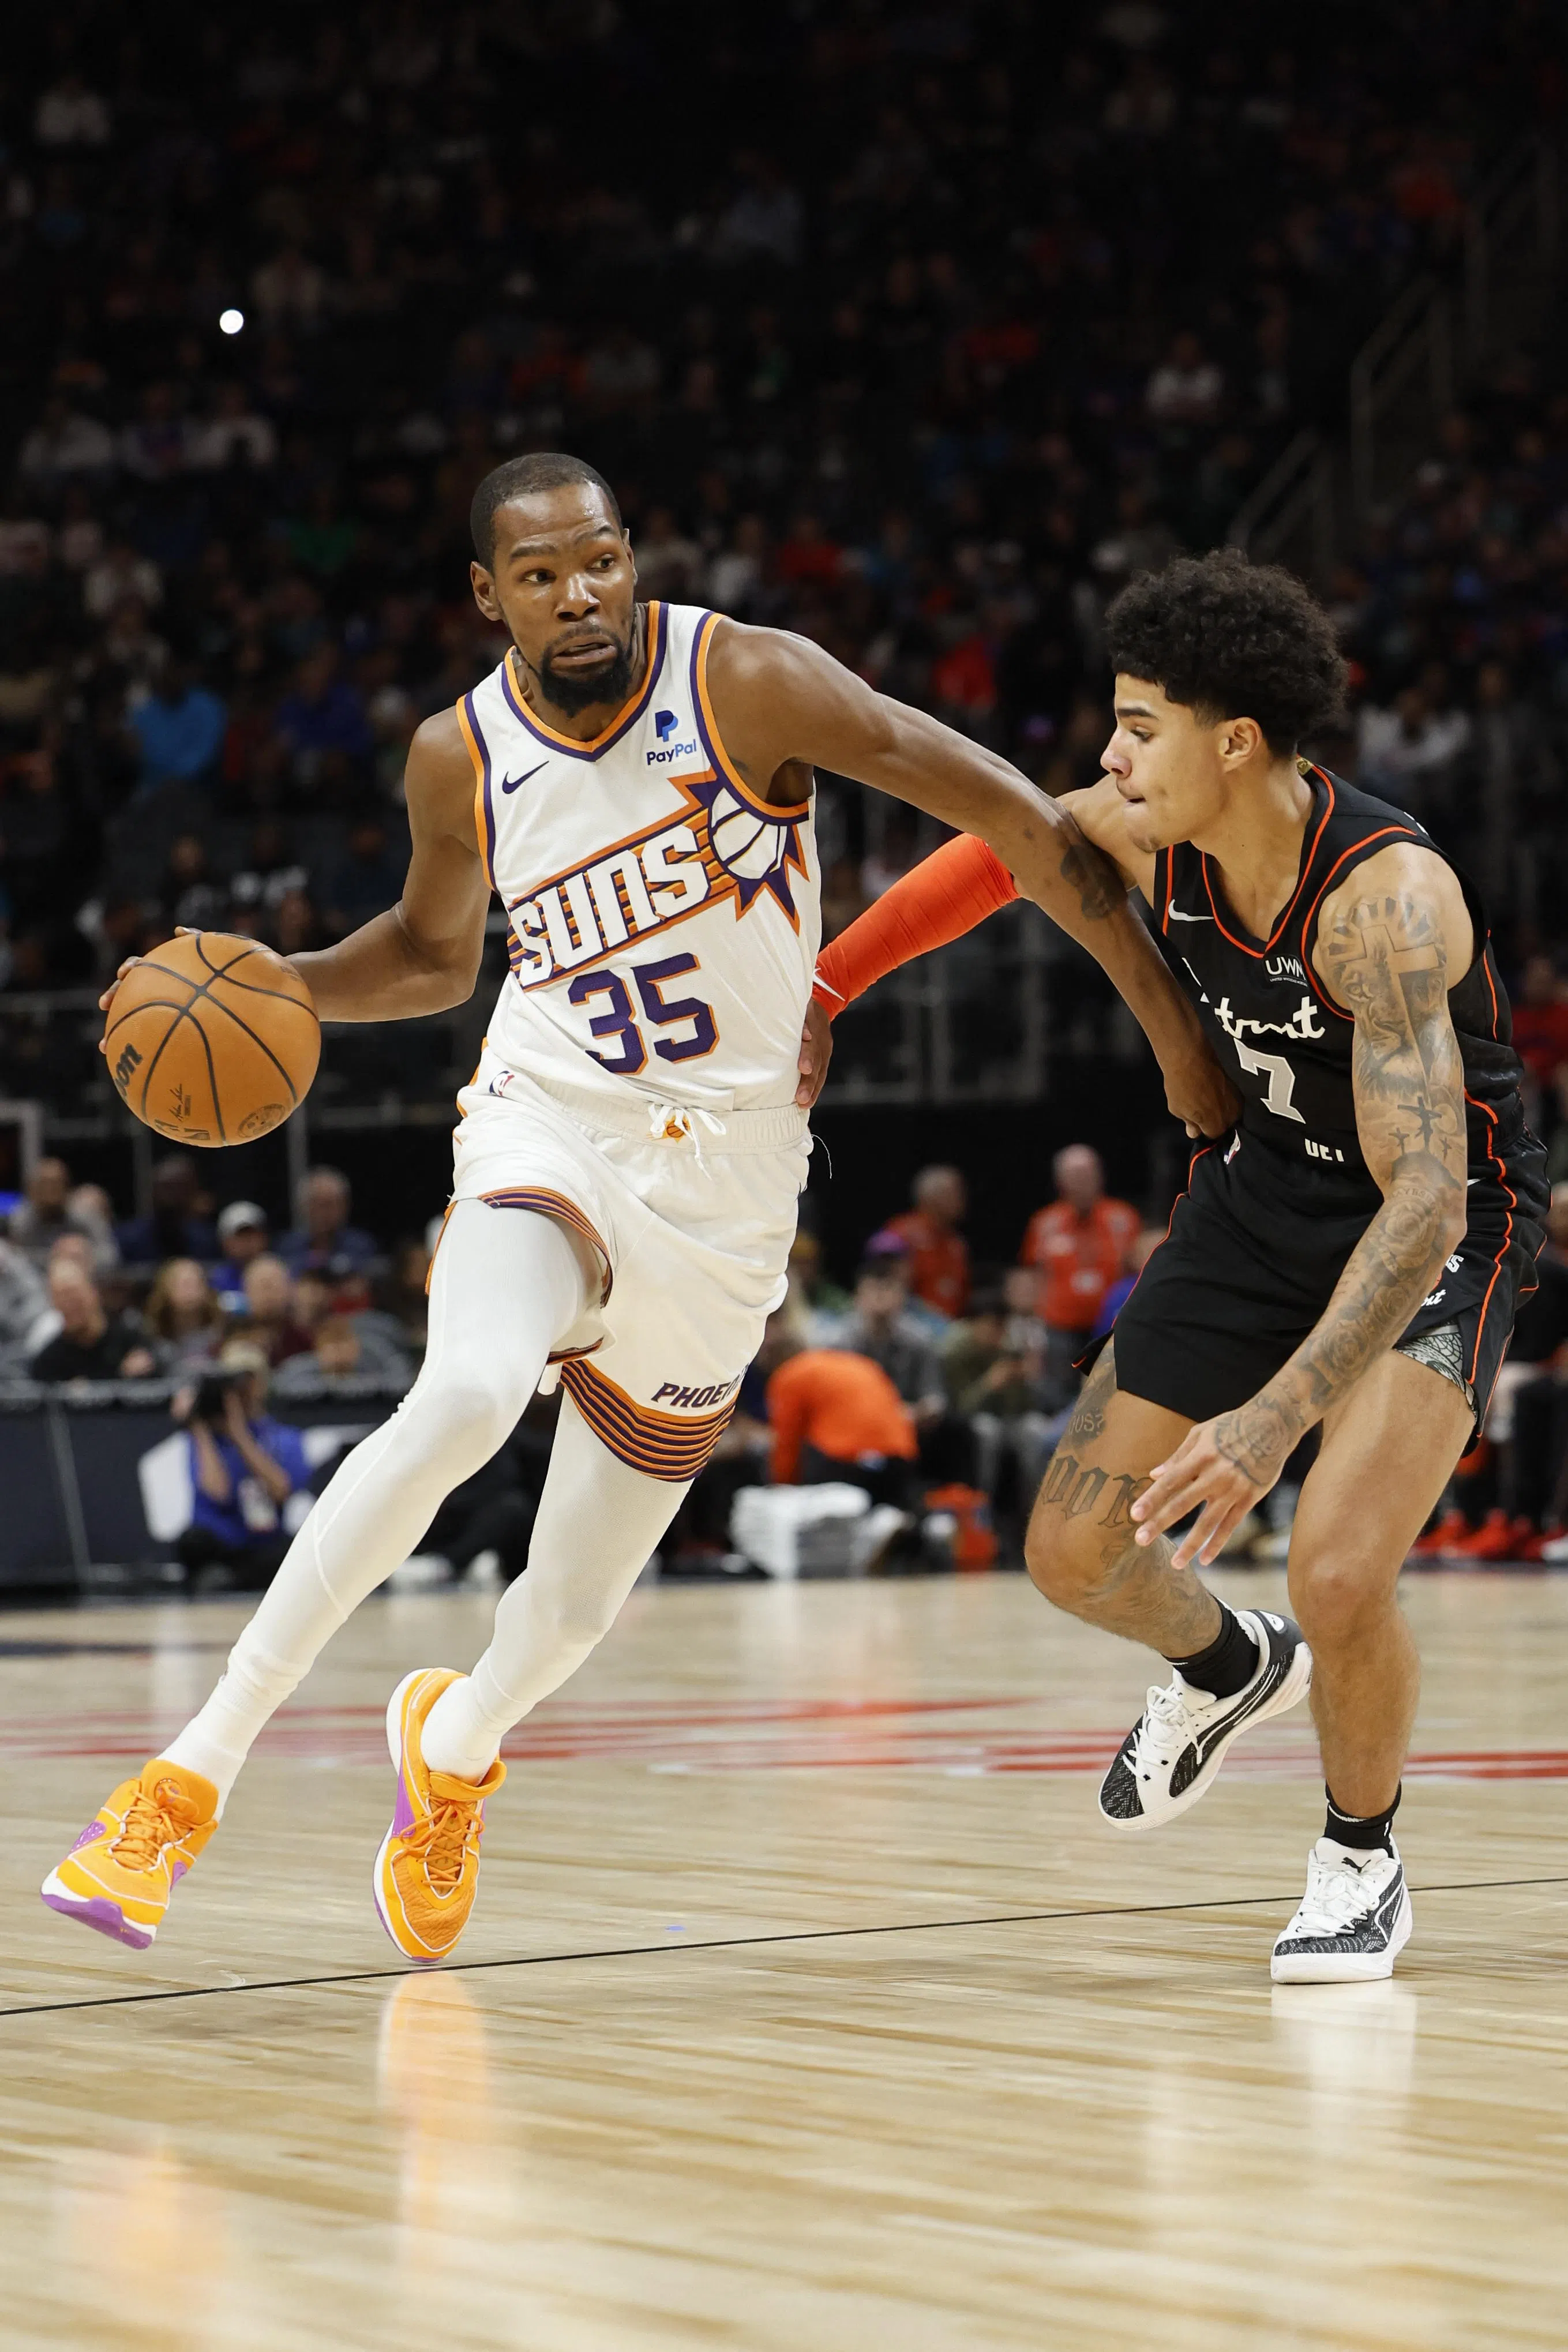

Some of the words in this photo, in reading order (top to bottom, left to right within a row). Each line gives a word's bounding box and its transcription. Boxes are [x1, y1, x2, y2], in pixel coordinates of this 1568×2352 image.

[647, 739, 697, 766] PayPal
[509, 823, 711, 987] SUNS
[1265, 956, 1306, 981] UWM
[567, 952, 720, 1075] 35
[1234, 1038, 1306, 1124] 7
